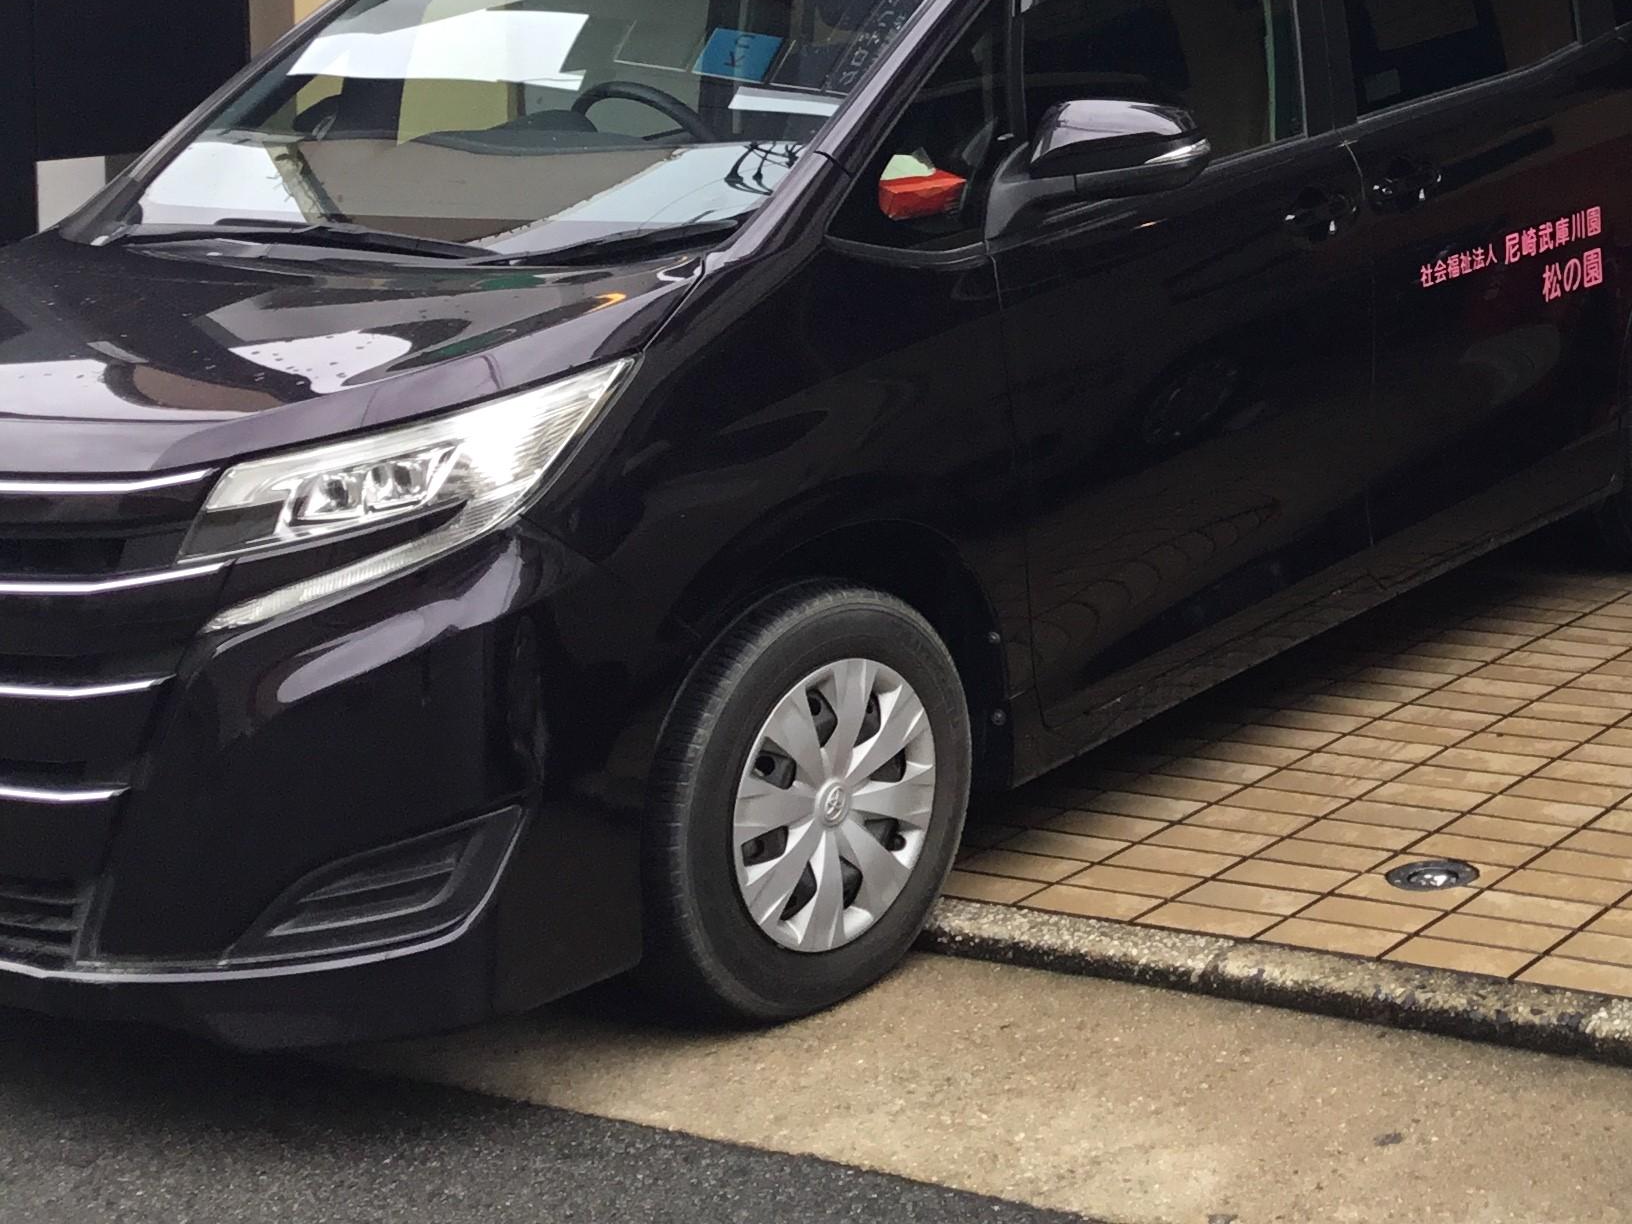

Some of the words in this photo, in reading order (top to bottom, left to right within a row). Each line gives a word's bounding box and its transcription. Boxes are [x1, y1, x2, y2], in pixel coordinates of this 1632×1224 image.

[1420, 242, 1498, 288] 社会福祉法人
[1504, 206, 1602, 265] 尼崎武庫川園
[1541, 247, 1603, 303] 松の園
